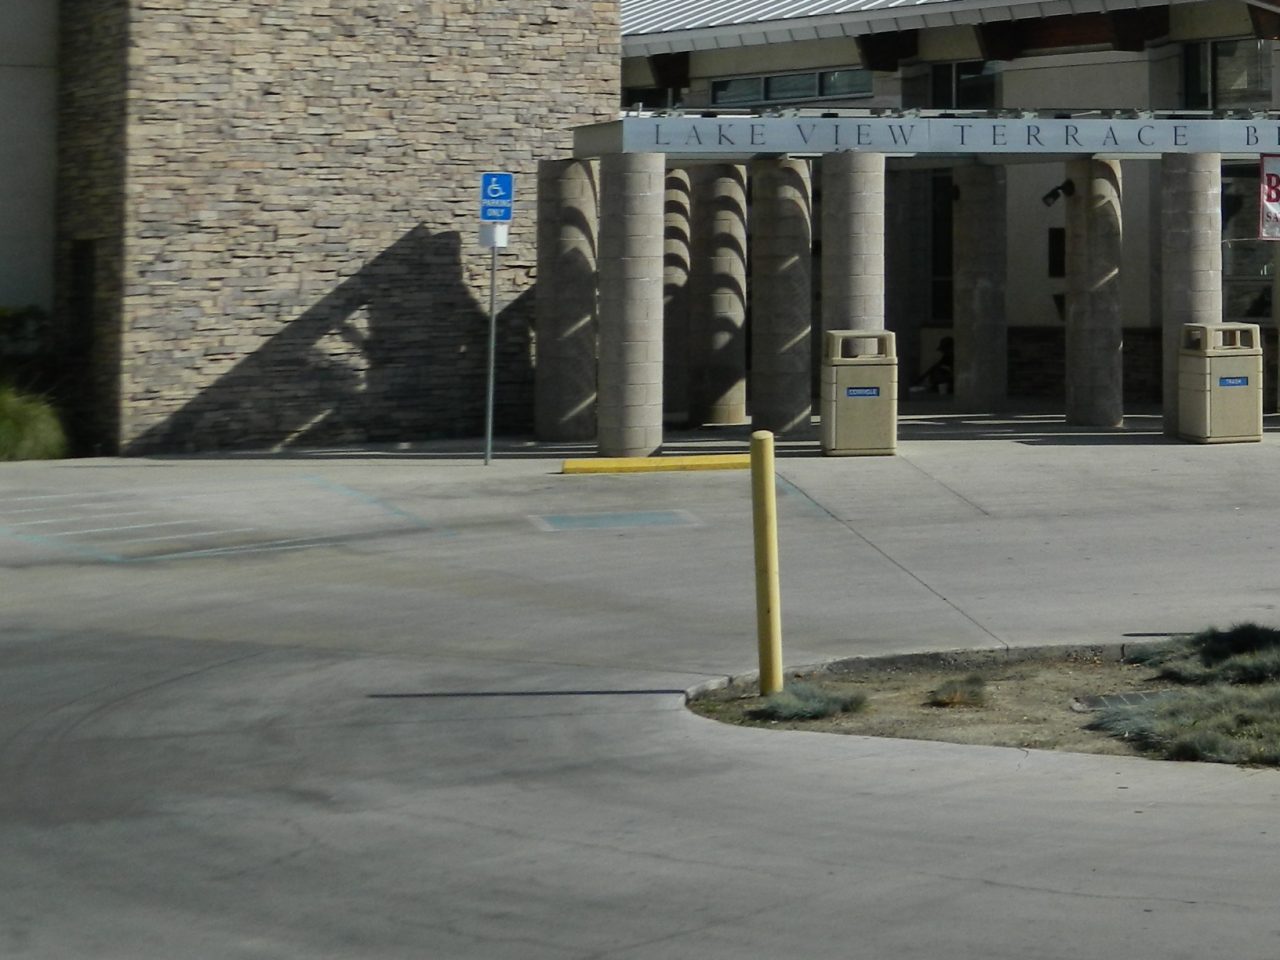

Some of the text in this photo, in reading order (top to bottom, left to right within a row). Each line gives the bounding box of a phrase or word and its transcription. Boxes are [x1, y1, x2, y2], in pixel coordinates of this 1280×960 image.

[654, 124, 767, 146] LAKE
[795, 124, 916, 146] VIEW
[953, 124, 1189, 146] TERRACE
[487, 208, 505, 217] ONLY
